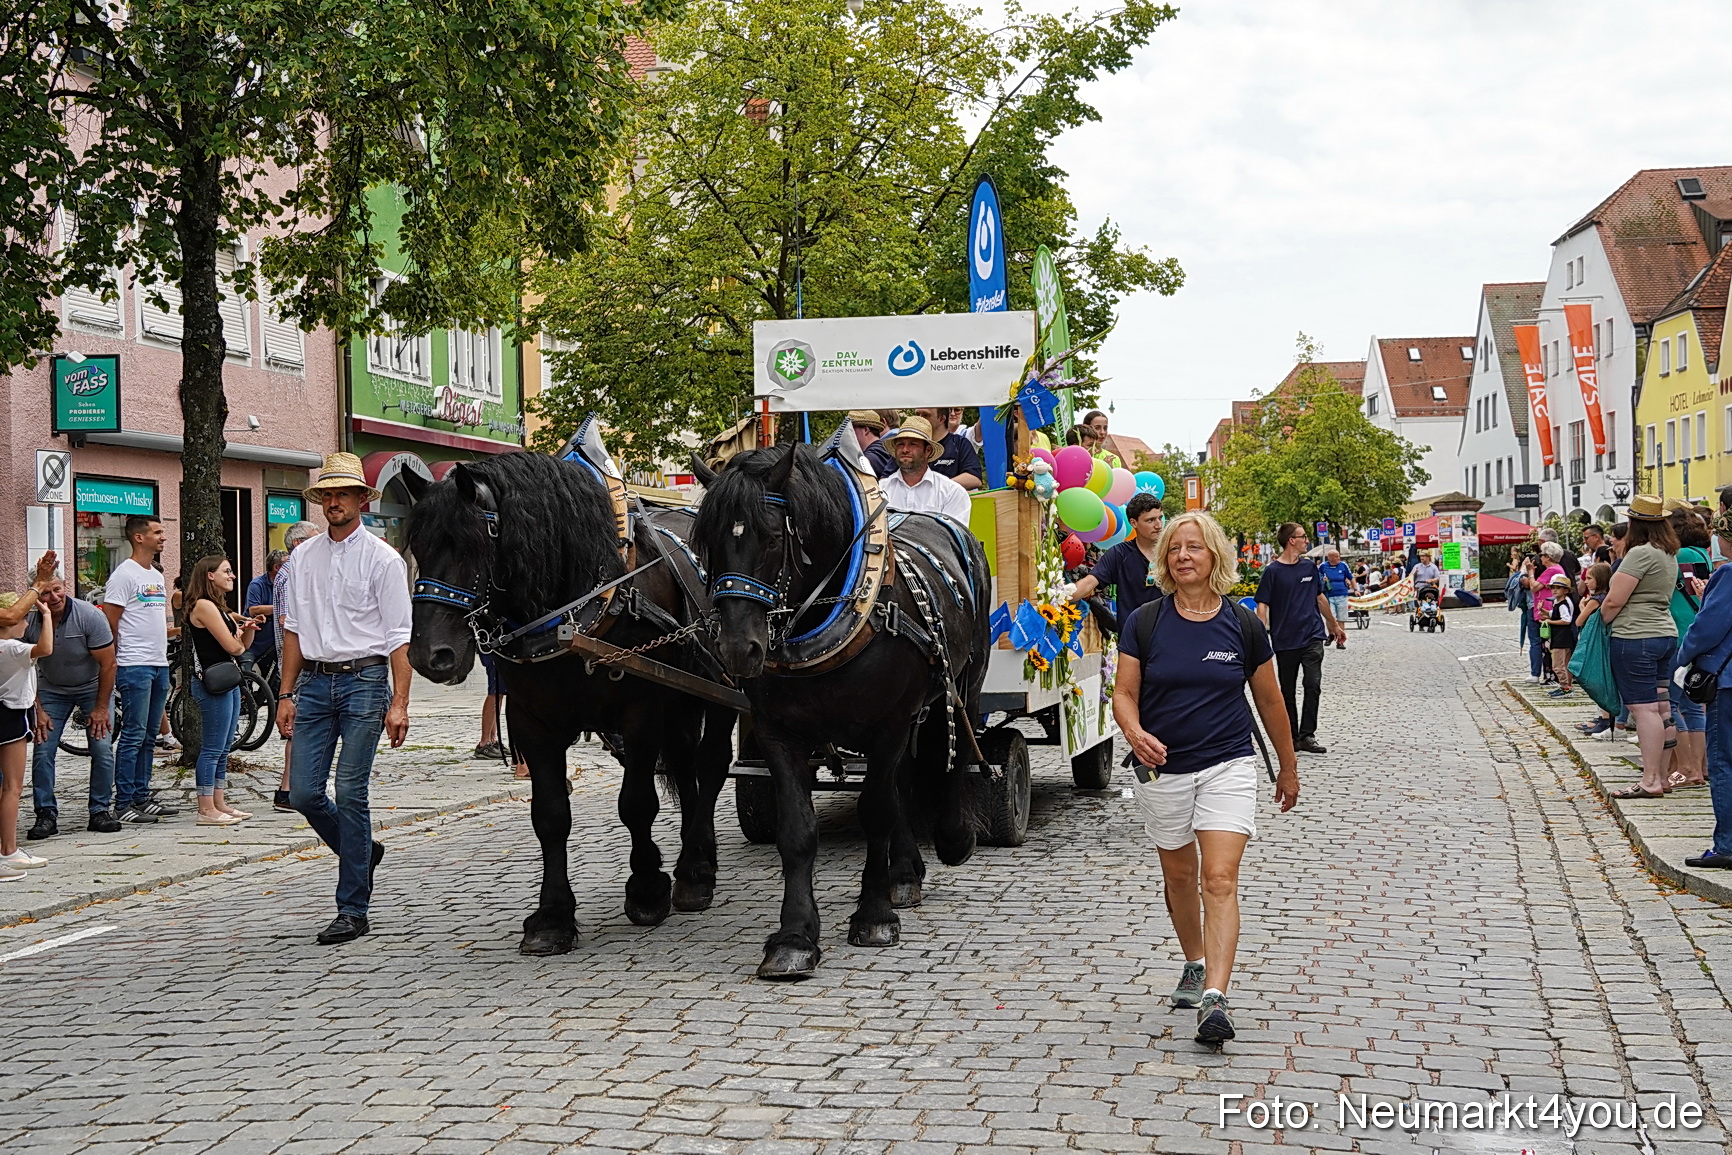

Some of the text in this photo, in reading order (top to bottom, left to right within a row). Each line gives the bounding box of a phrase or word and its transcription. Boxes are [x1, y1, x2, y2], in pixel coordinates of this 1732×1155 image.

[837, 351, 858, 359] DAV
[930, 345, 1020, 361] Lebenshilfe
[821, 359, 873, 367] ZENTRUM
[930, 362, 985, 371] Neumarkt e.V.
[64, 370, 88, 384] vom
[1573, 345, 1599, 406] SALE
[73, 374, 108, 395] FASS
[1669, 392, 1689, 412] HOTEL
[46, 491, 63, 500] ZONE
[76, 487, 152, 511] Spirituosen Whisky
[270, 502, 286, 519] Essig
[1202, 651, 1229, 661] JURA
